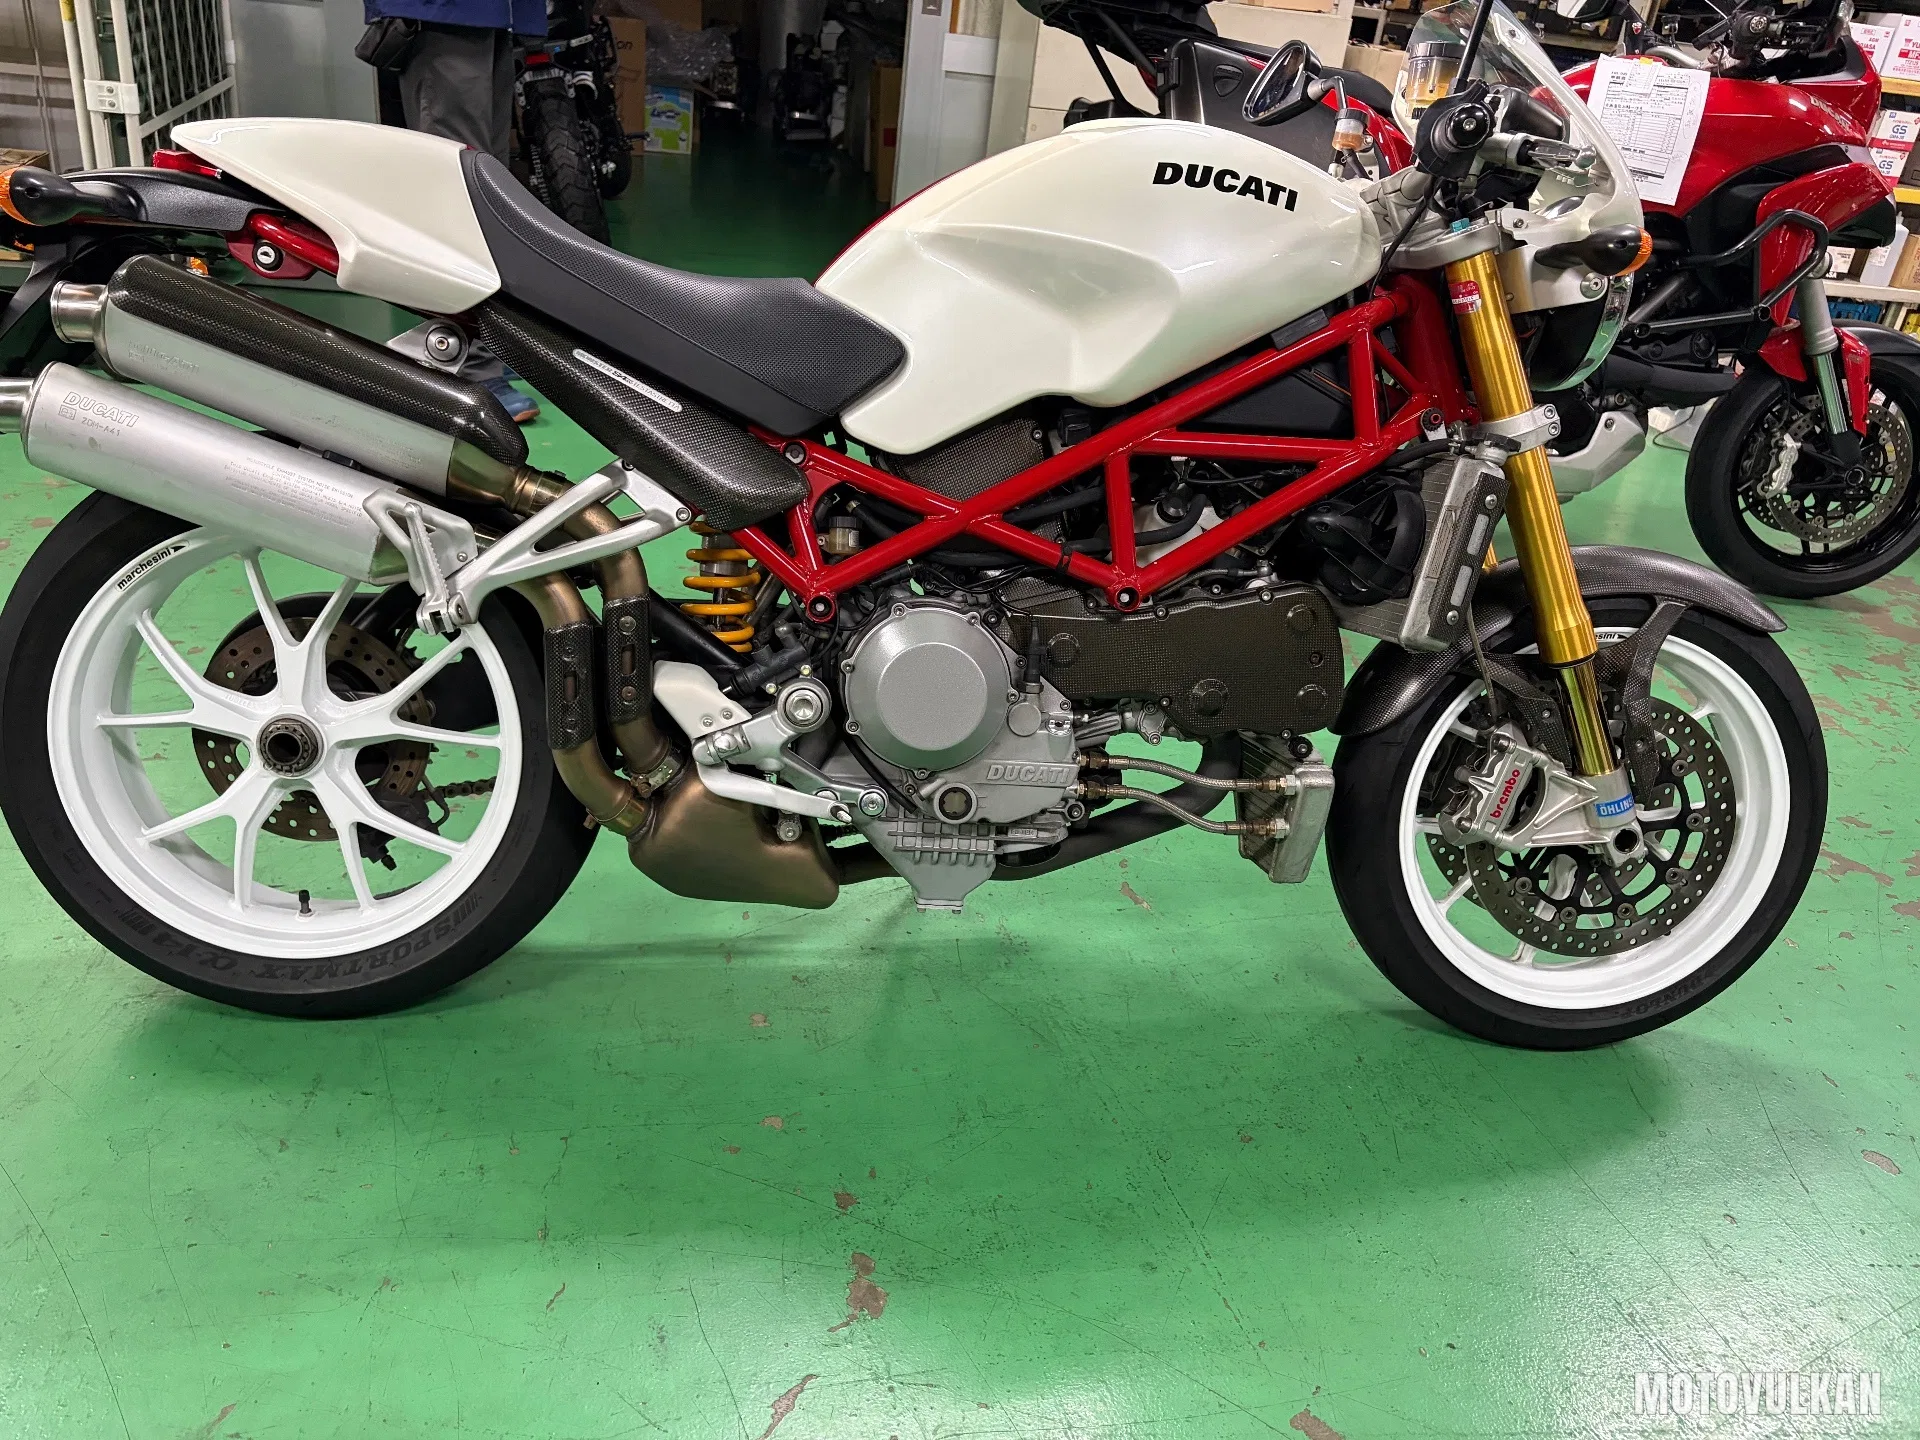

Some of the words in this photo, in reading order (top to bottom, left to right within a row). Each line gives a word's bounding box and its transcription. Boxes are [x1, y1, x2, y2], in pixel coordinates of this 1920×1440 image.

[1892, 124, 1908, 135] GS
[1878, 160, 1894, 170] GS
[1152, 161, 1299, 213] DUCATI
[62, 391, 140, 428] DUCATI
[117, 547, 171, 590] marchesini
[986, 764, 1071, 784] DUCATI
[1490, 769, 1521, 819] brembo
